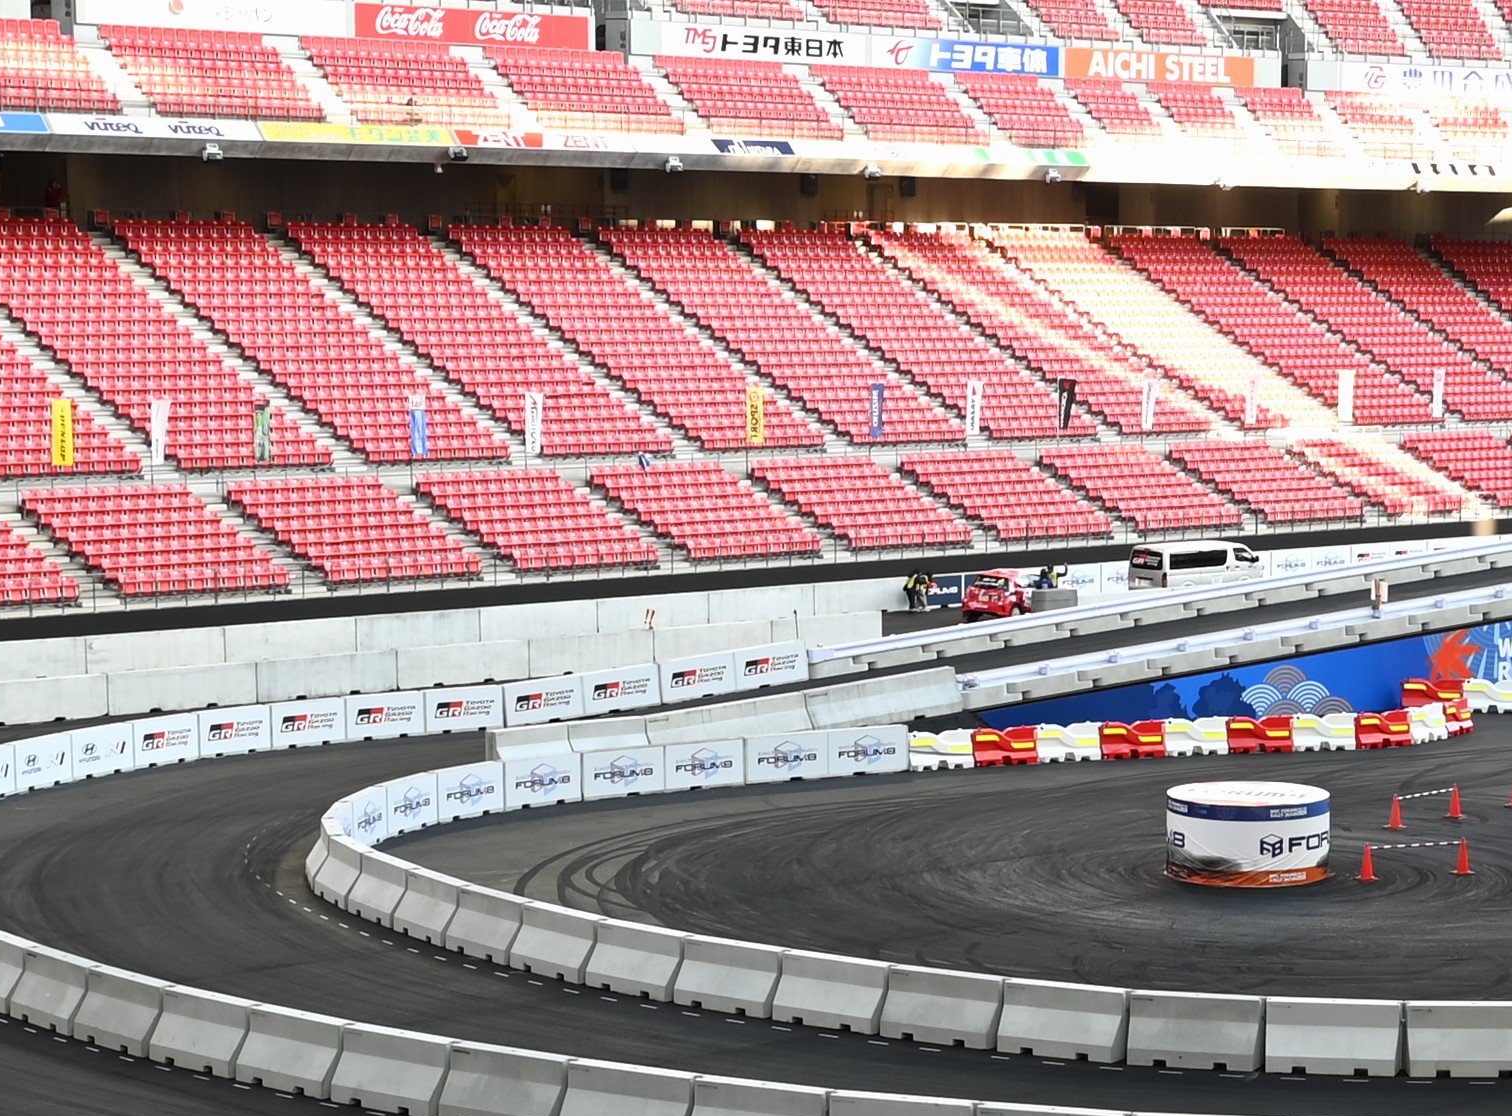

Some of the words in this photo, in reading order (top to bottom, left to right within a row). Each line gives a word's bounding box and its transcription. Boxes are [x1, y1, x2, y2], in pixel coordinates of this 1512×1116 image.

[720, 34, 844, 58] トヨタ東日本
[928, 45, 1048, 74] トヨタ車体
[1088, 51, 1155, 80] AICHI
[1165, 55, 1231, 83] STEEL
[477, 131, 524, 147] ZENT
[563, 135, 608, 149] ZENT
[744, 665, 769, 676] GR
[671, 677, 696, 688] GR
[593, 689, 619, 700] GR
[435, 706, 463, 718] GR
[515, 699, 542, 712] GR
[356, 712, 384, 725] GR
[281, 720, 306, 732] GR
[208, 729, 233, 741] GR
[142, 738, 164, 751] GR
